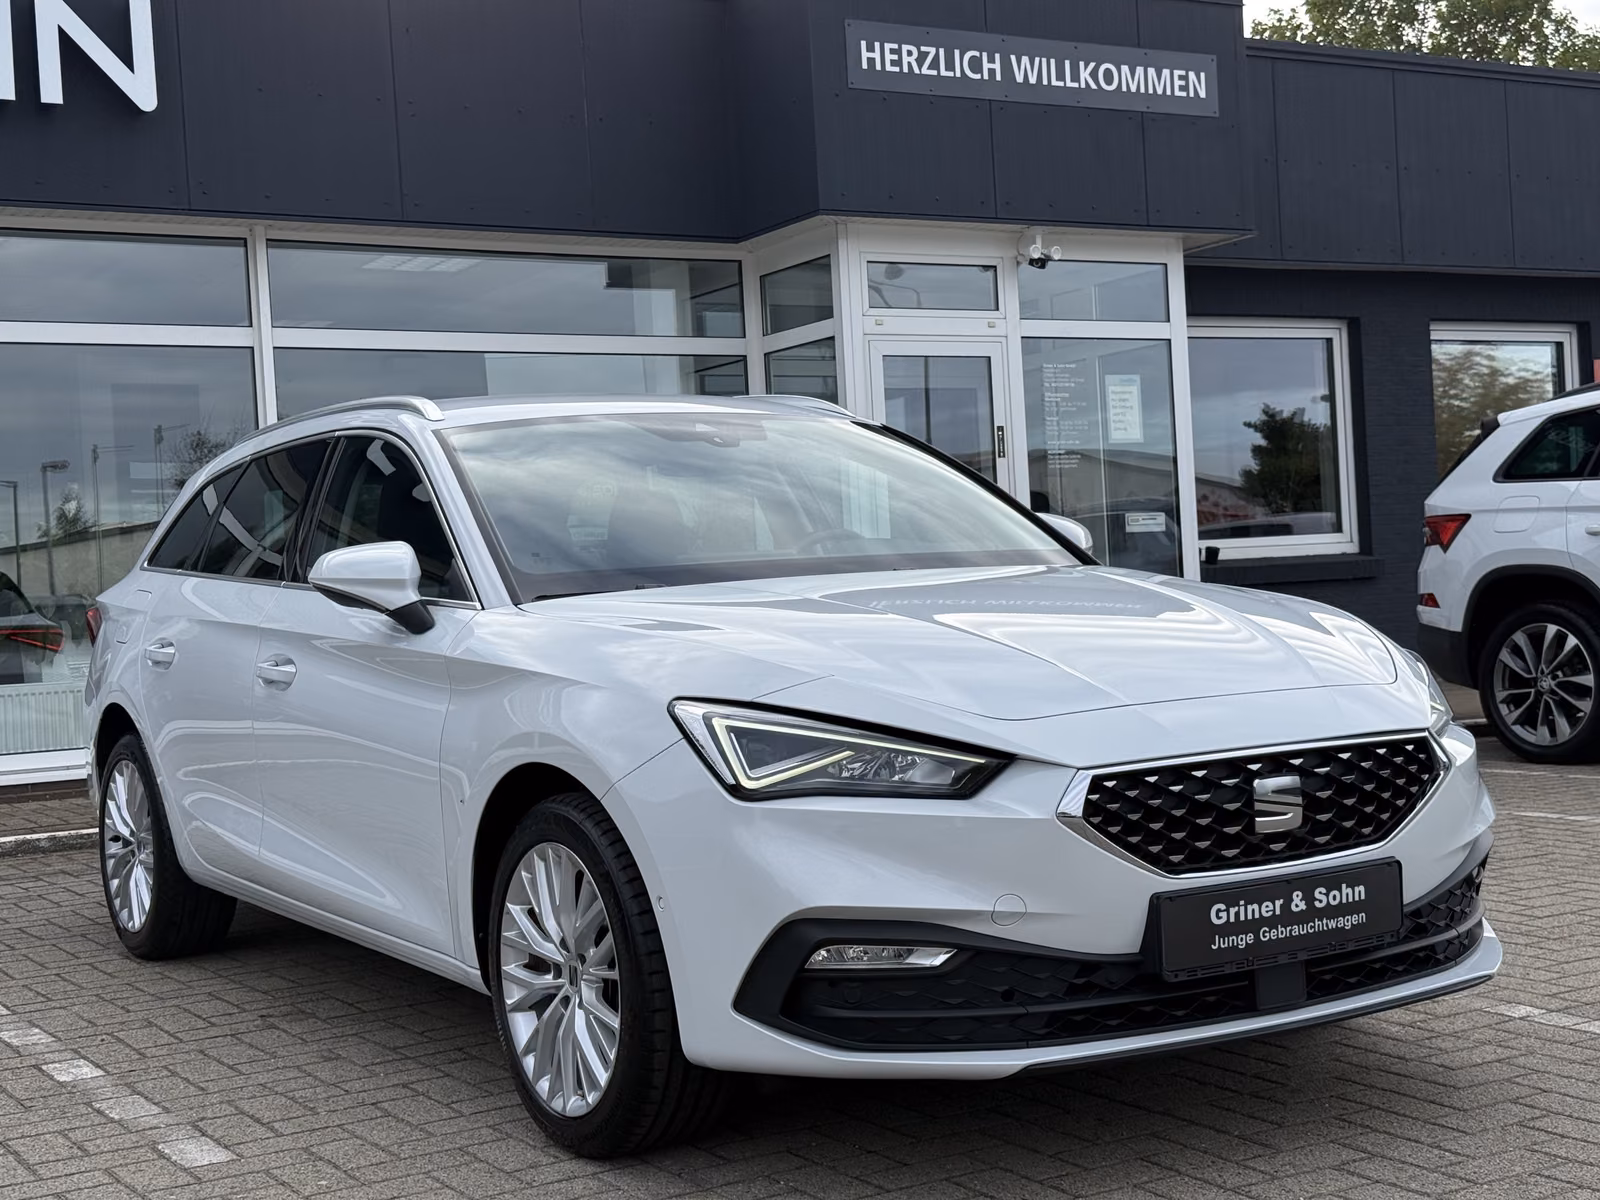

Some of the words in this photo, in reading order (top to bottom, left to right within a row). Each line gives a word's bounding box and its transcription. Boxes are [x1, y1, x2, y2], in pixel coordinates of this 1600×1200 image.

[860, 40, 1001, 81] HERZLICH
[1010, 54, 1206, 98] WILLKOMMEN
[1210, 897, 1284, 925] Griner
[1290, 891, 1307, 912] &
[1314, 883, 1365, 908] Sohn
[1211, 933, 1254, 949] Junge
[1259, 912, 1366, 941] Gebrauchtwagen
